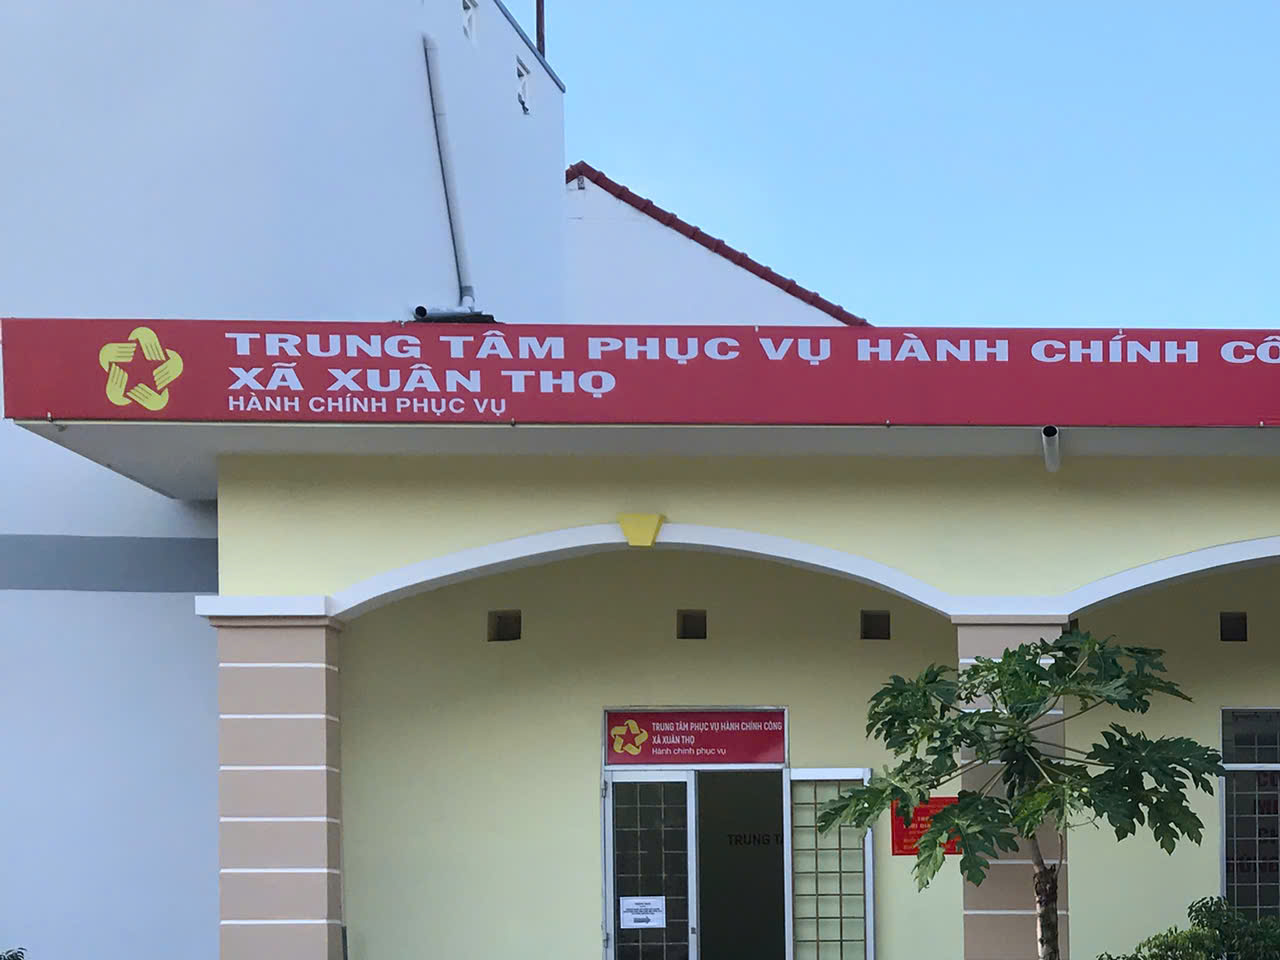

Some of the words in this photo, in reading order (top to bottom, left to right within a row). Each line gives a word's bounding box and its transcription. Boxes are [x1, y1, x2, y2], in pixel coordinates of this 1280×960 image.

[225, 333, 421, 358] TRUNG
[440, 330, 565, 359] TÂM
[588, 336, 740, 364] PHỤC
[760, 337, 831, 366] VỤ
[857, 333, 1009, 362] HÀNH
[1031, 334, 1199, 363] CHÍNH
[228, 362, 304, 391] XÃ
[326, 363, 481, 393] XUÂN
[501, 370, 616, 398] THỌ
[228, 393, 300, 412] HÀNH
[308, 393, 387, 413] CHÍNH
[396, 398, 465, 416] PHỤC
[474, 398, 506, 416] VỤ
[652, 722, 675, 731] TRUNG
[675, 720, 689, 731] TÂM
[690, 722, 709, 733] PHỤC
[710, 722, 720, 733] VỤ
[720, 720, 740, 731] HÀNH
[740, 720, 763, 731] CHÍNH
[763, 720, 783, 731] CÔNG
[727, 833, 770, 846] TRUNG
